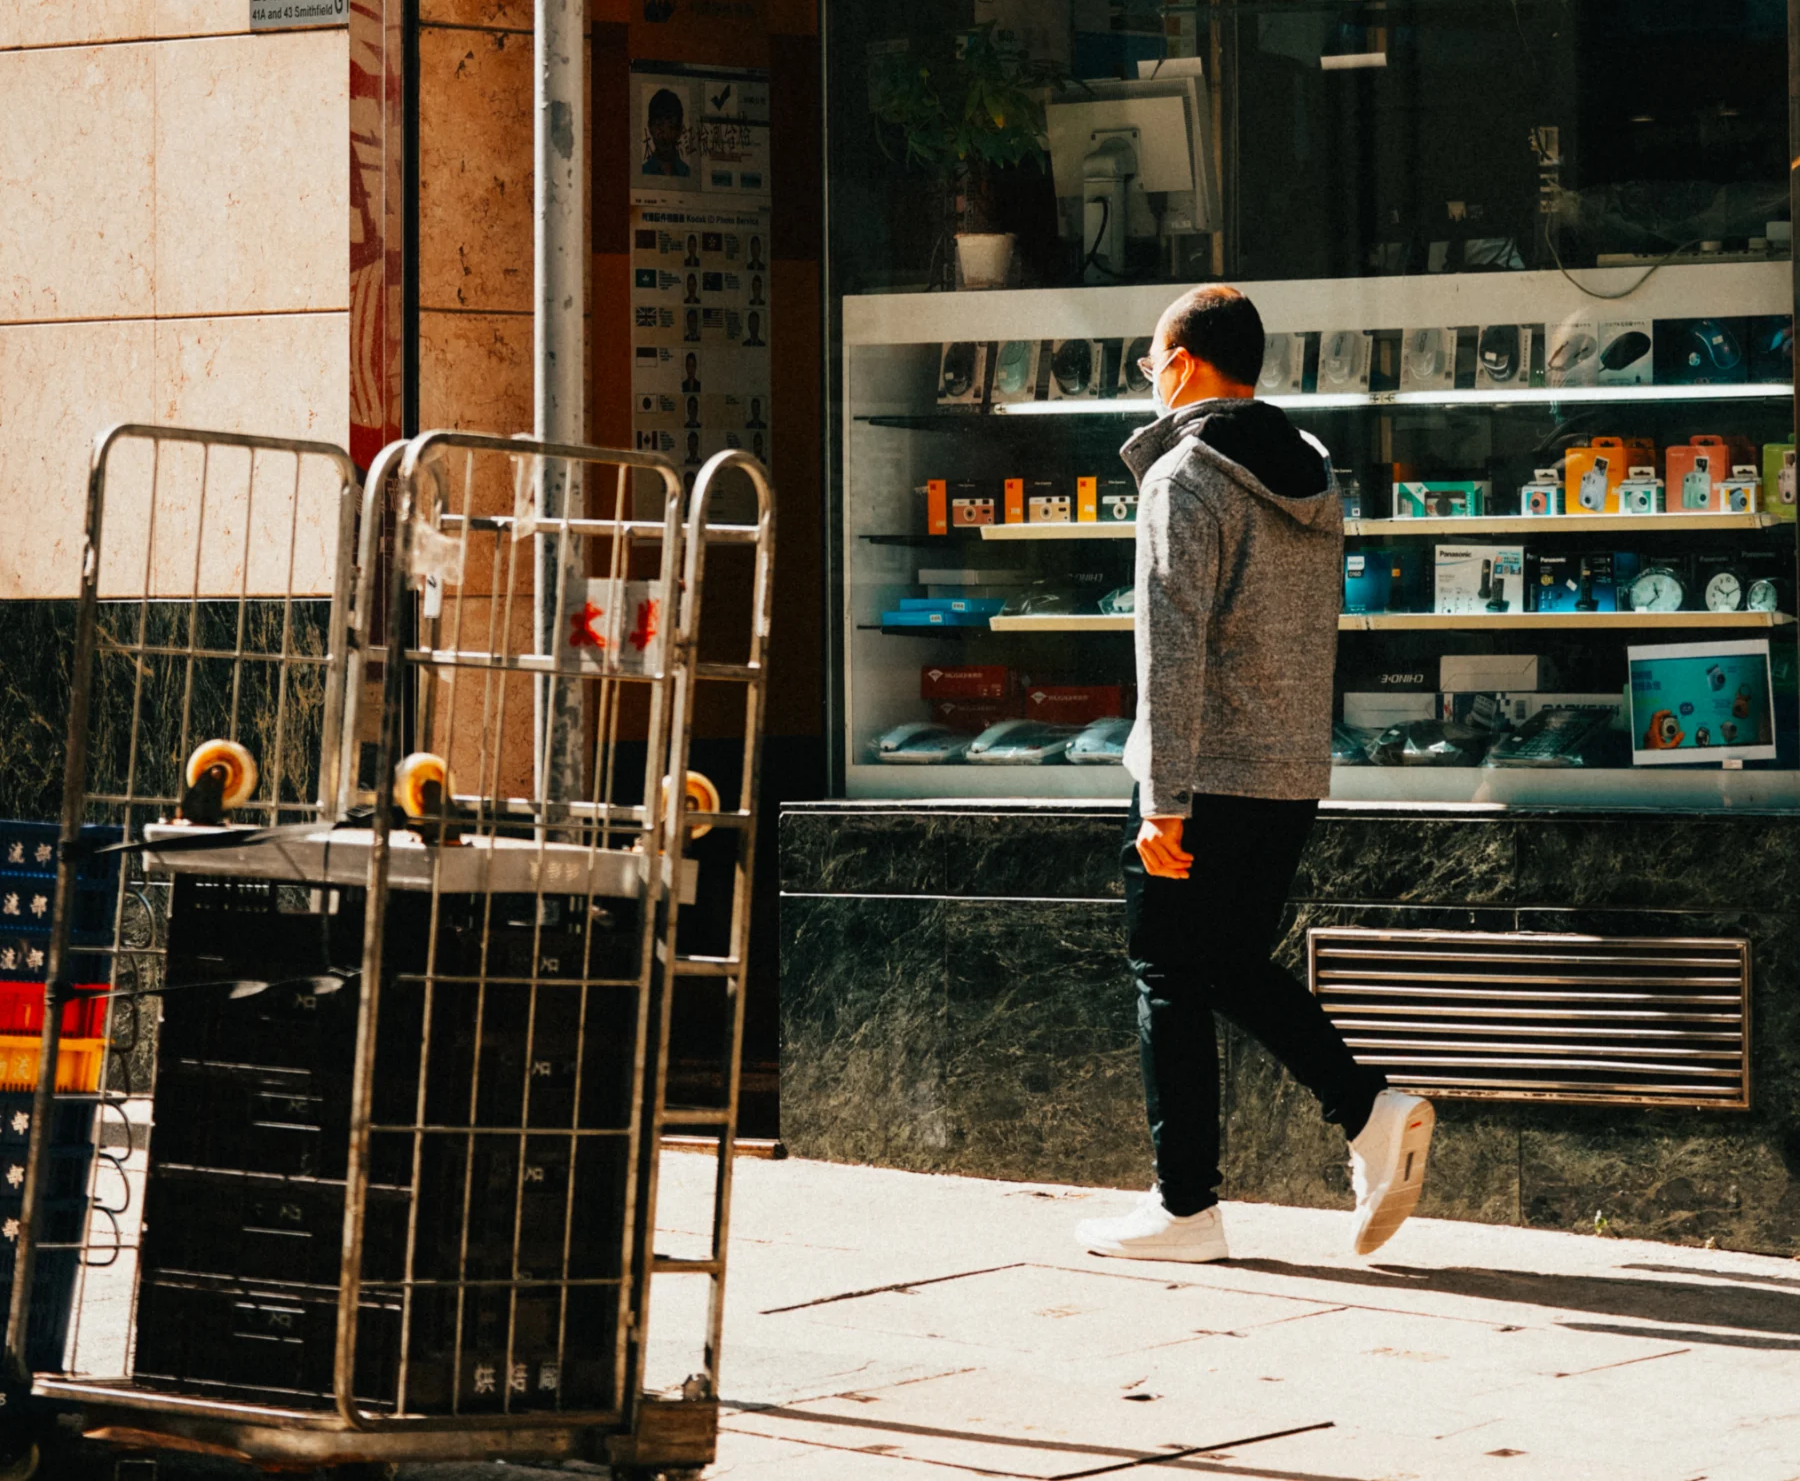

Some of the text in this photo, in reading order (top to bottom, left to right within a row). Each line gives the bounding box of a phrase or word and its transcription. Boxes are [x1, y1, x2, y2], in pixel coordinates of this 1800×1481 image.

[252, 3, 333, 20] 41A and 43 Smithfield
[1439, 550, 1472, 559] Panasonic
[1540, 555, 1567, 564] Panasonic
